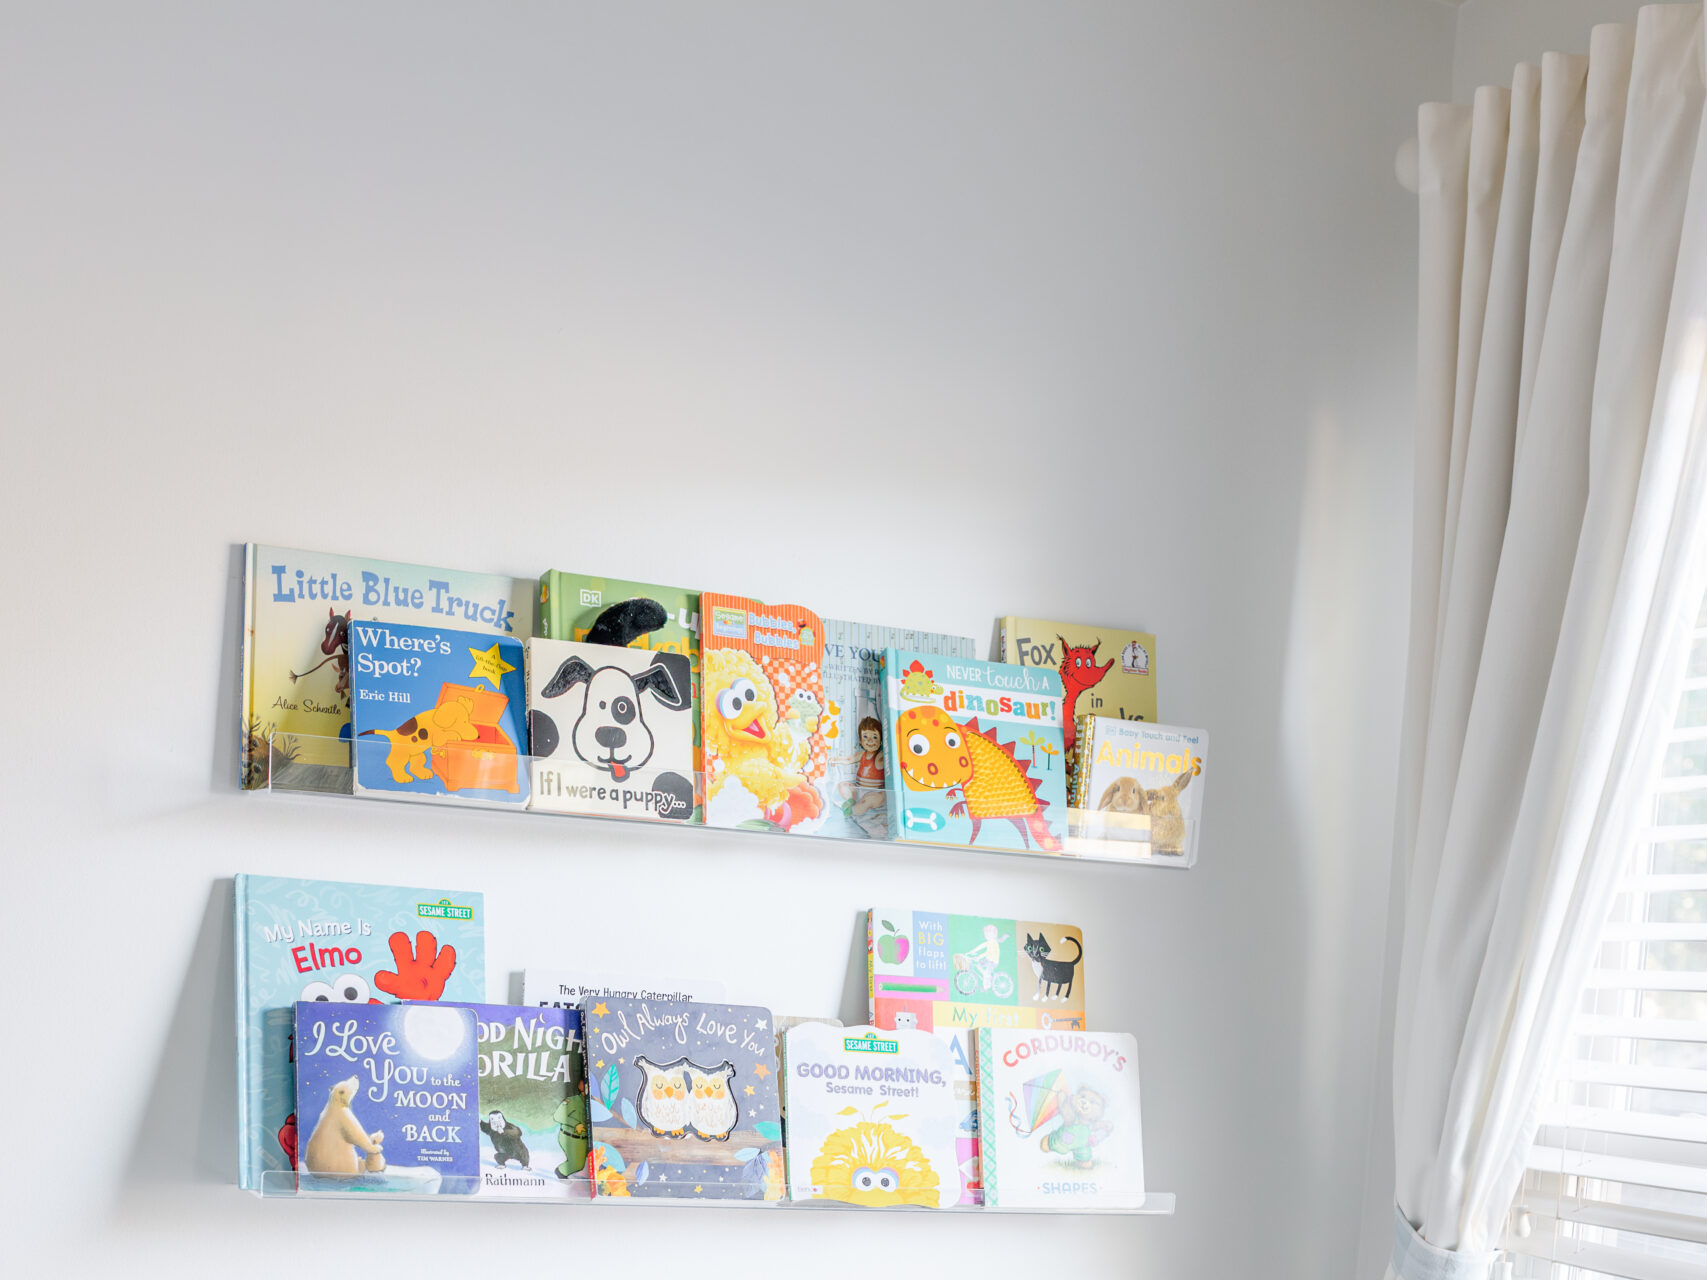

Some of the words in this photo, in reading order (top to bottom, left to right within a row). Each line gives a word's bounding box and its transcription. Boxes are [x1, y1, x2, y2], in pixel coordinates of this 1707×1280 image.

[272, 565, 353, 603] Little
[361, 571, 424, 609] Blue
[428, 579, 514, 632] Truck
[583, 593, 600, 603] DK
[748, 611, 797, 634] Bubbles,
[356, 626, 451, 655] Where's
[754, 631, 799, 650] Bubbles
[849, 646, 880, 663] YOU
[357, 652, 422, 678] Spot?
[946, 665, 982, 682] NEVER
[983, 665, 1039, 691] touch
[1041, 678, 1050, 690] A
[271, 696, 299, 711] Alice
[302, 699, 341, 715] Schertle
[359, 689, 385, 702] Eric
[388, 690, 411, 704] Hill
[943, 689, 1056, 721] dinosaur!
[1091, 692, 1103, 709] in
[1118, 727, 1140, 739] Baby
[1141, 730, 1163, 740] Touch
[1096, 740, 1202, 776] Animals
[540, 771, 553, 796] If
[557, 773, 561, 796] I
[565, 785, 606, 800] were
[609, 788, 619, 801] a
[623, 789, 686, 814] puppy...
[419, 905, 446, 917] SESAME
[446, 907, 470, 918] STREET
[263, 924, 295, 944] My
[298, 919, 353, 938] Name
[357, 917, 372, 936] Is
[918, 920, 944, 933] With
[917, 932, 945, 946] BIG
[291, 942, 363, 974] Elmo
[918, 947, 945, 960] flaps
[916, 960, 926, 969] to
[926, 959, 947, 971] lift!
[559, 984, 576, 996] The
[578, 985, 601, 998] Very
[603, 988, 638, 1000] Hungry
[640, 989, 693, 1003] Caterpillar
[952, 1007, 978, 1027] My
[986, 1007, 1019, 1026] first
[601, 1010, 641, 1055] Owl
[637, 1003, 690, 1045] Always
[696, 1012, 738, 1044] Love
[739, 1028, 766, 1057] You
[304, 1021, 326, 1056] I
[325, 1019, 400, 1062] Love
[845, 1039, 872, 1050] SESAME
[872, 1041, 897, 1053] STREET
[1002, 1035, 1127, 1072] CORDUROY'S
[478, 1050, 571, 1083] ORILLA
[796, 1062, 850, 1080] GOOD
[854, 1065, 947, 1087] MORNING,
[431, 1076, 441, 1086] to
[442, 1074, 461, 1087] the
[826, 1082, 873, 1096] Sesame
[879, 1084, 919, 1098] Street!
[393, 1090, 467, 1110] MOON
[428, 1109, 451, 1122] and
[401, 1124, 462, 1144] BACK
[485, 1172, 546, 1187] Rathmann
[1042, 1182, 1097, 1194] SHAPES
